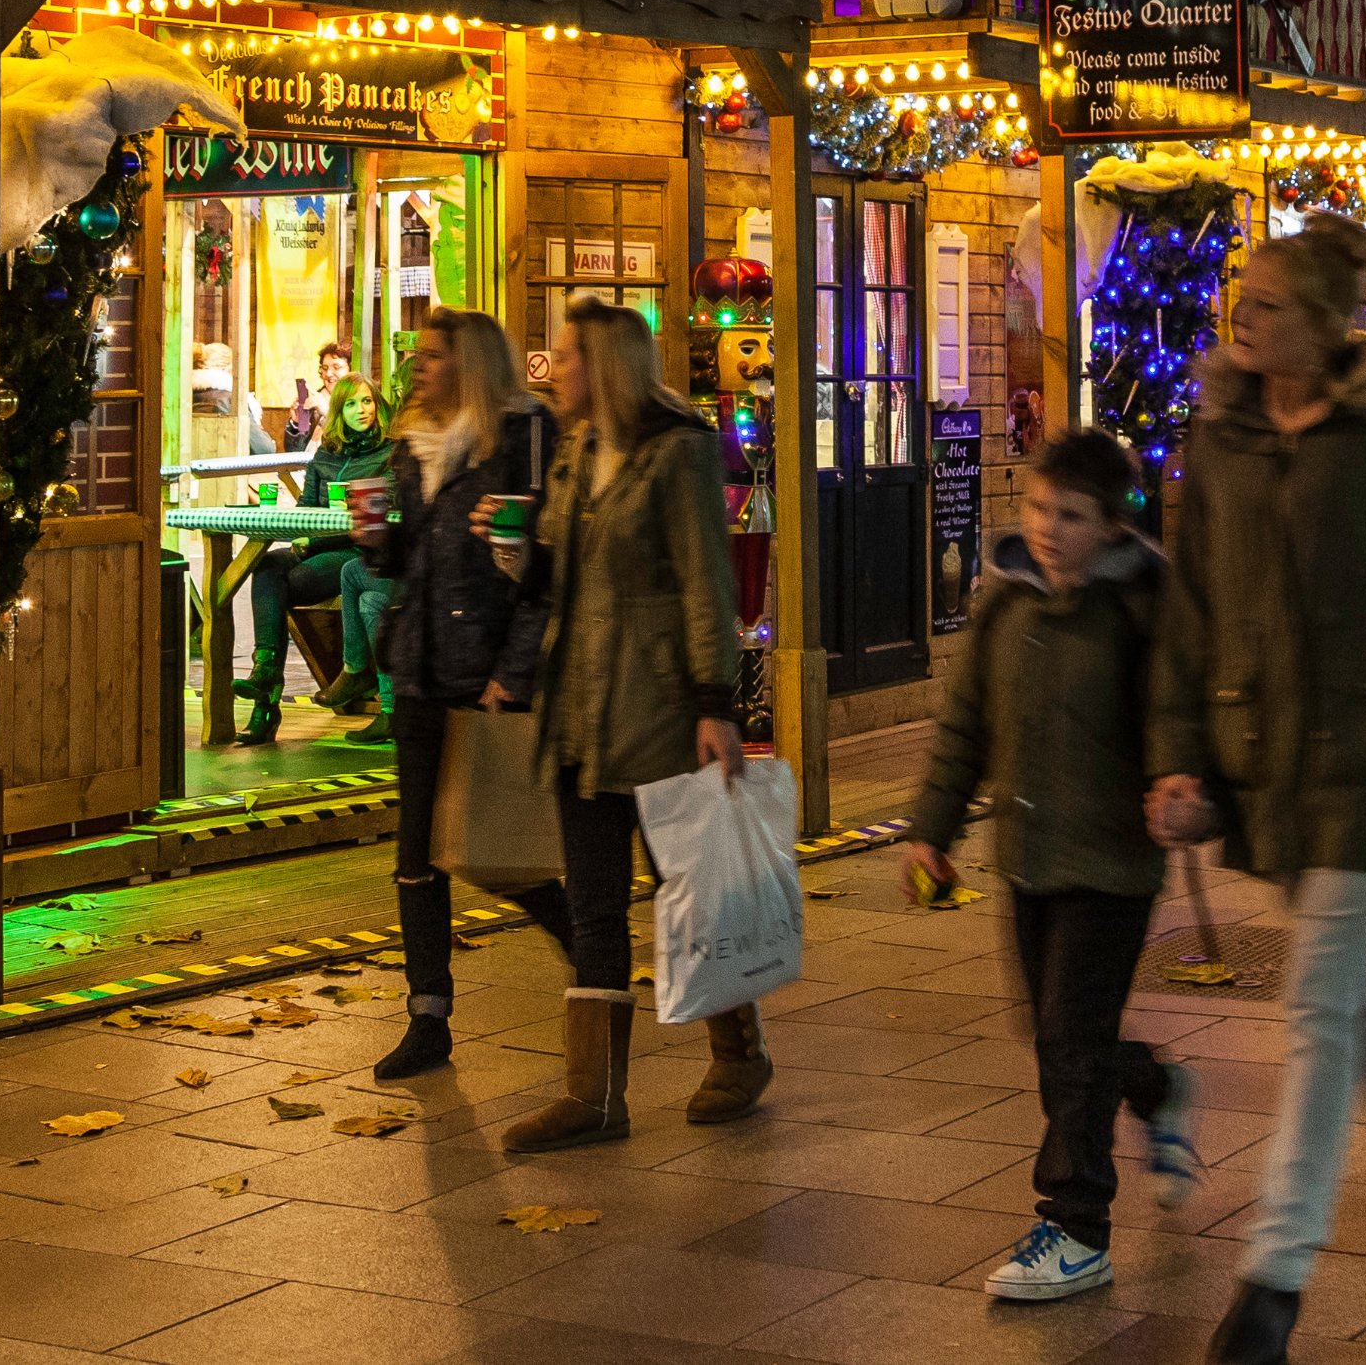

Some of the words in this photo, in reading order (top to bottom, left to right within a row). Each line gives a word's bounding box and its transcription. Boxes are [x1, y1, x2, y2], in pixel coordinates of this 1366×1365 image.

[1054, 3, 1133, 38] Festive
[1065, 49, 1121, 70] Please
[1127, 50, 1167, 68] come
[1173, 44, 1222, 66] inside
[206, 64, 312, 110] French
[318, 71, 453, 114] Pancakes
[1176, 70, 1229, 96] festive
[284, 114, 306, 125] With
[319, 115, 341, 127] Choice
[343, 116, 354, 130] Of
[355, 118, 387, 130] Delicious
[389, 120, 416, 134] Fillings
[1090, 101, 1123, 126] food
[1128, 102, 1143, 121] &
[946, 442, 967, 458] Hot
[934, 460, 980, 479] Chocolate
